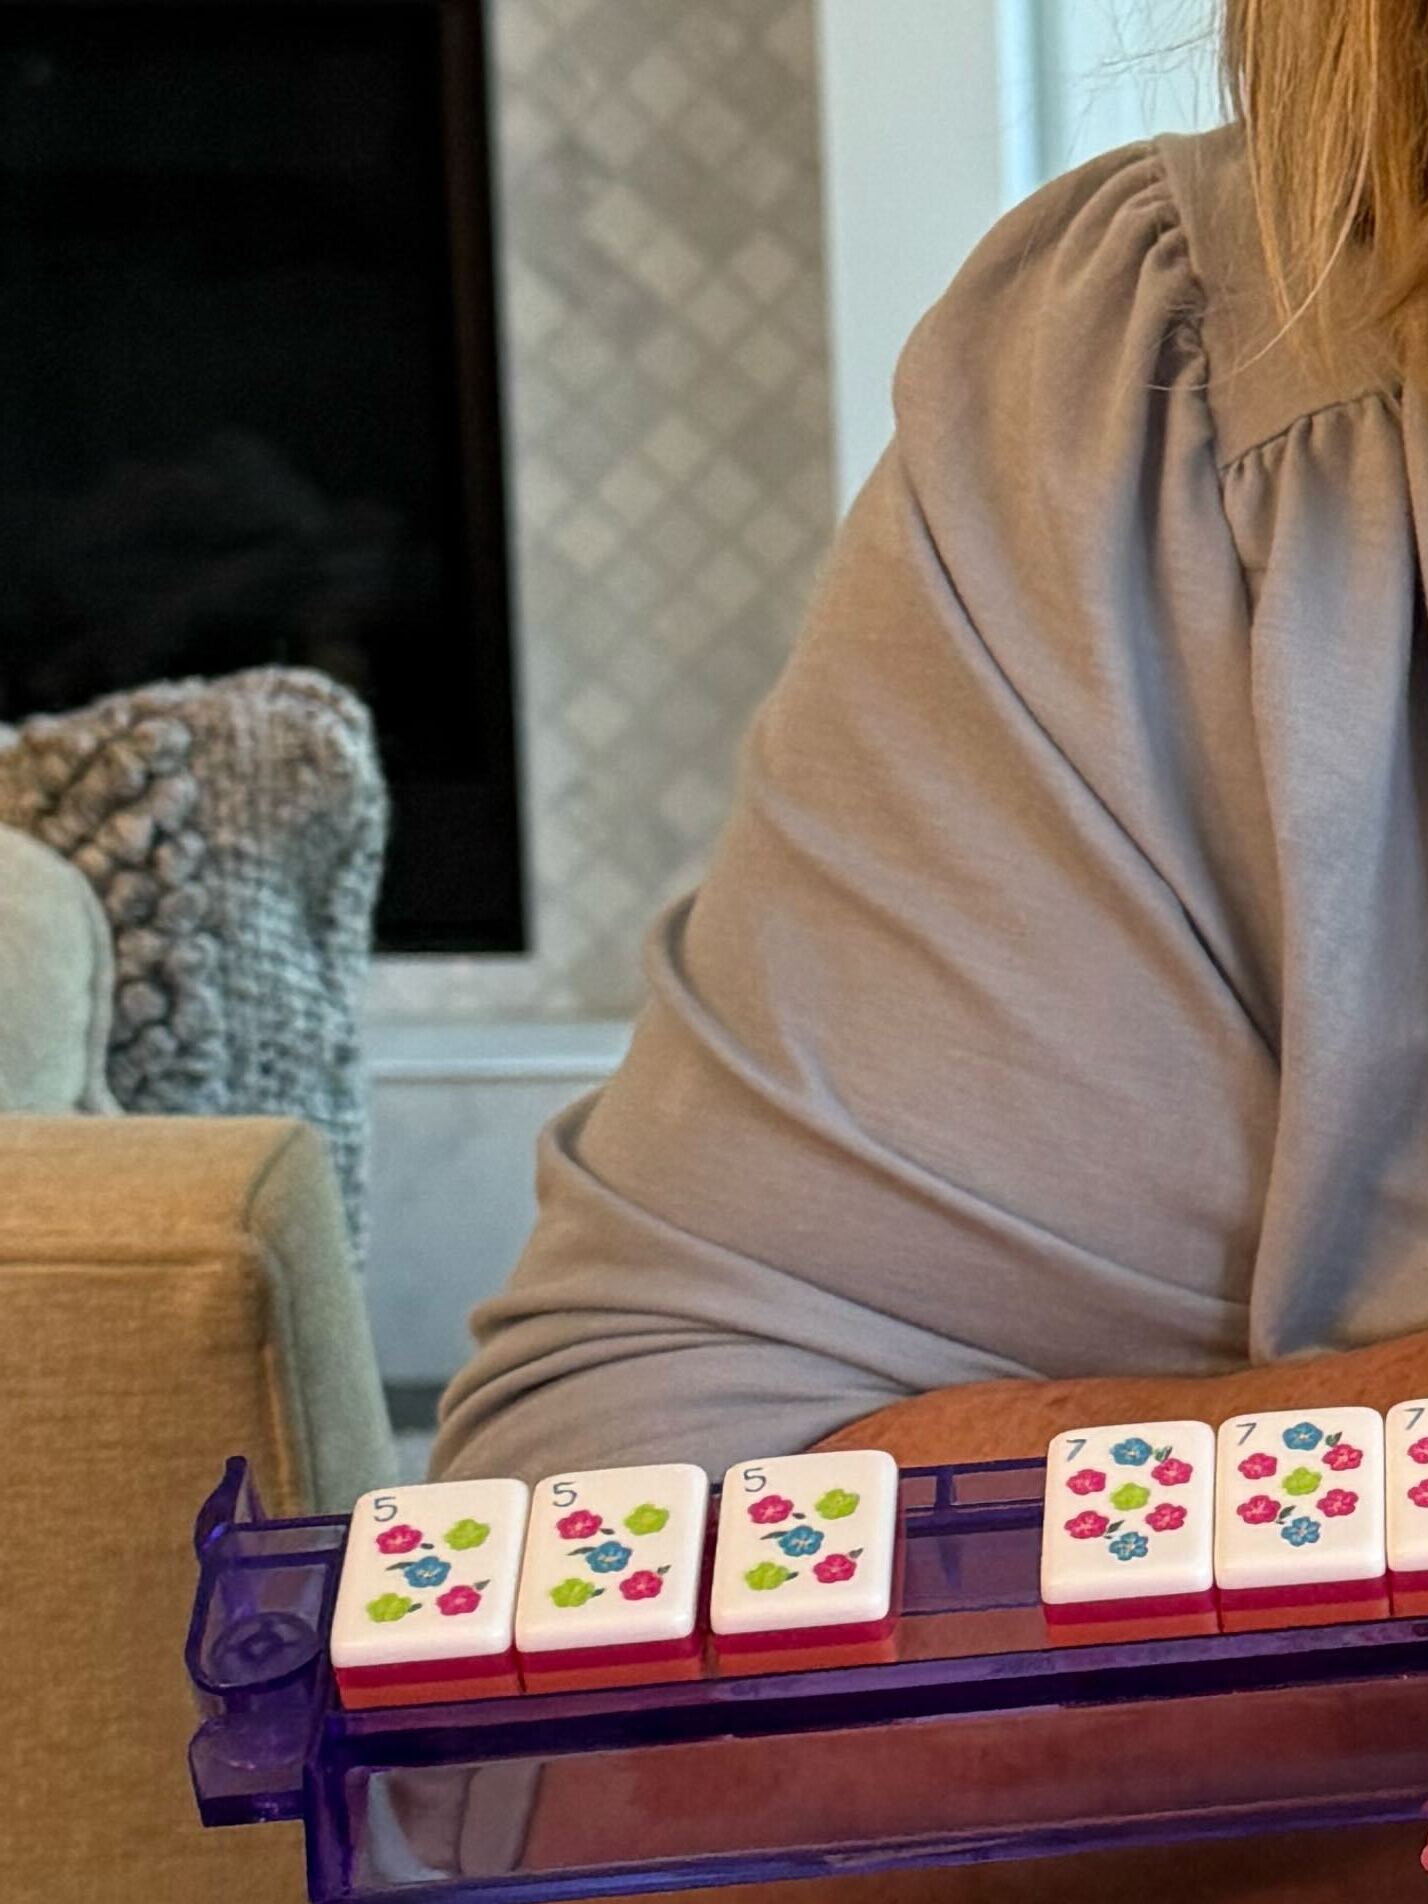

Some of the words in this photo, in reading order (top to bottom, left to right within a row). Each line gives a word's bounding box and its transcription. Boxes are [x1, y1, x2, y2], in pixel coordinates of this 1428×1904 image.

[1405, 1407, 1426, 1432] 7
[1236, 1423, 1259, 1447] 7
[1065, 1439, 1088, 1464] 7
[742, 1467, 766, 1492] 5
[553, 1482, 578, 1507] 5
[373, 1498, 398, 1522] 5
